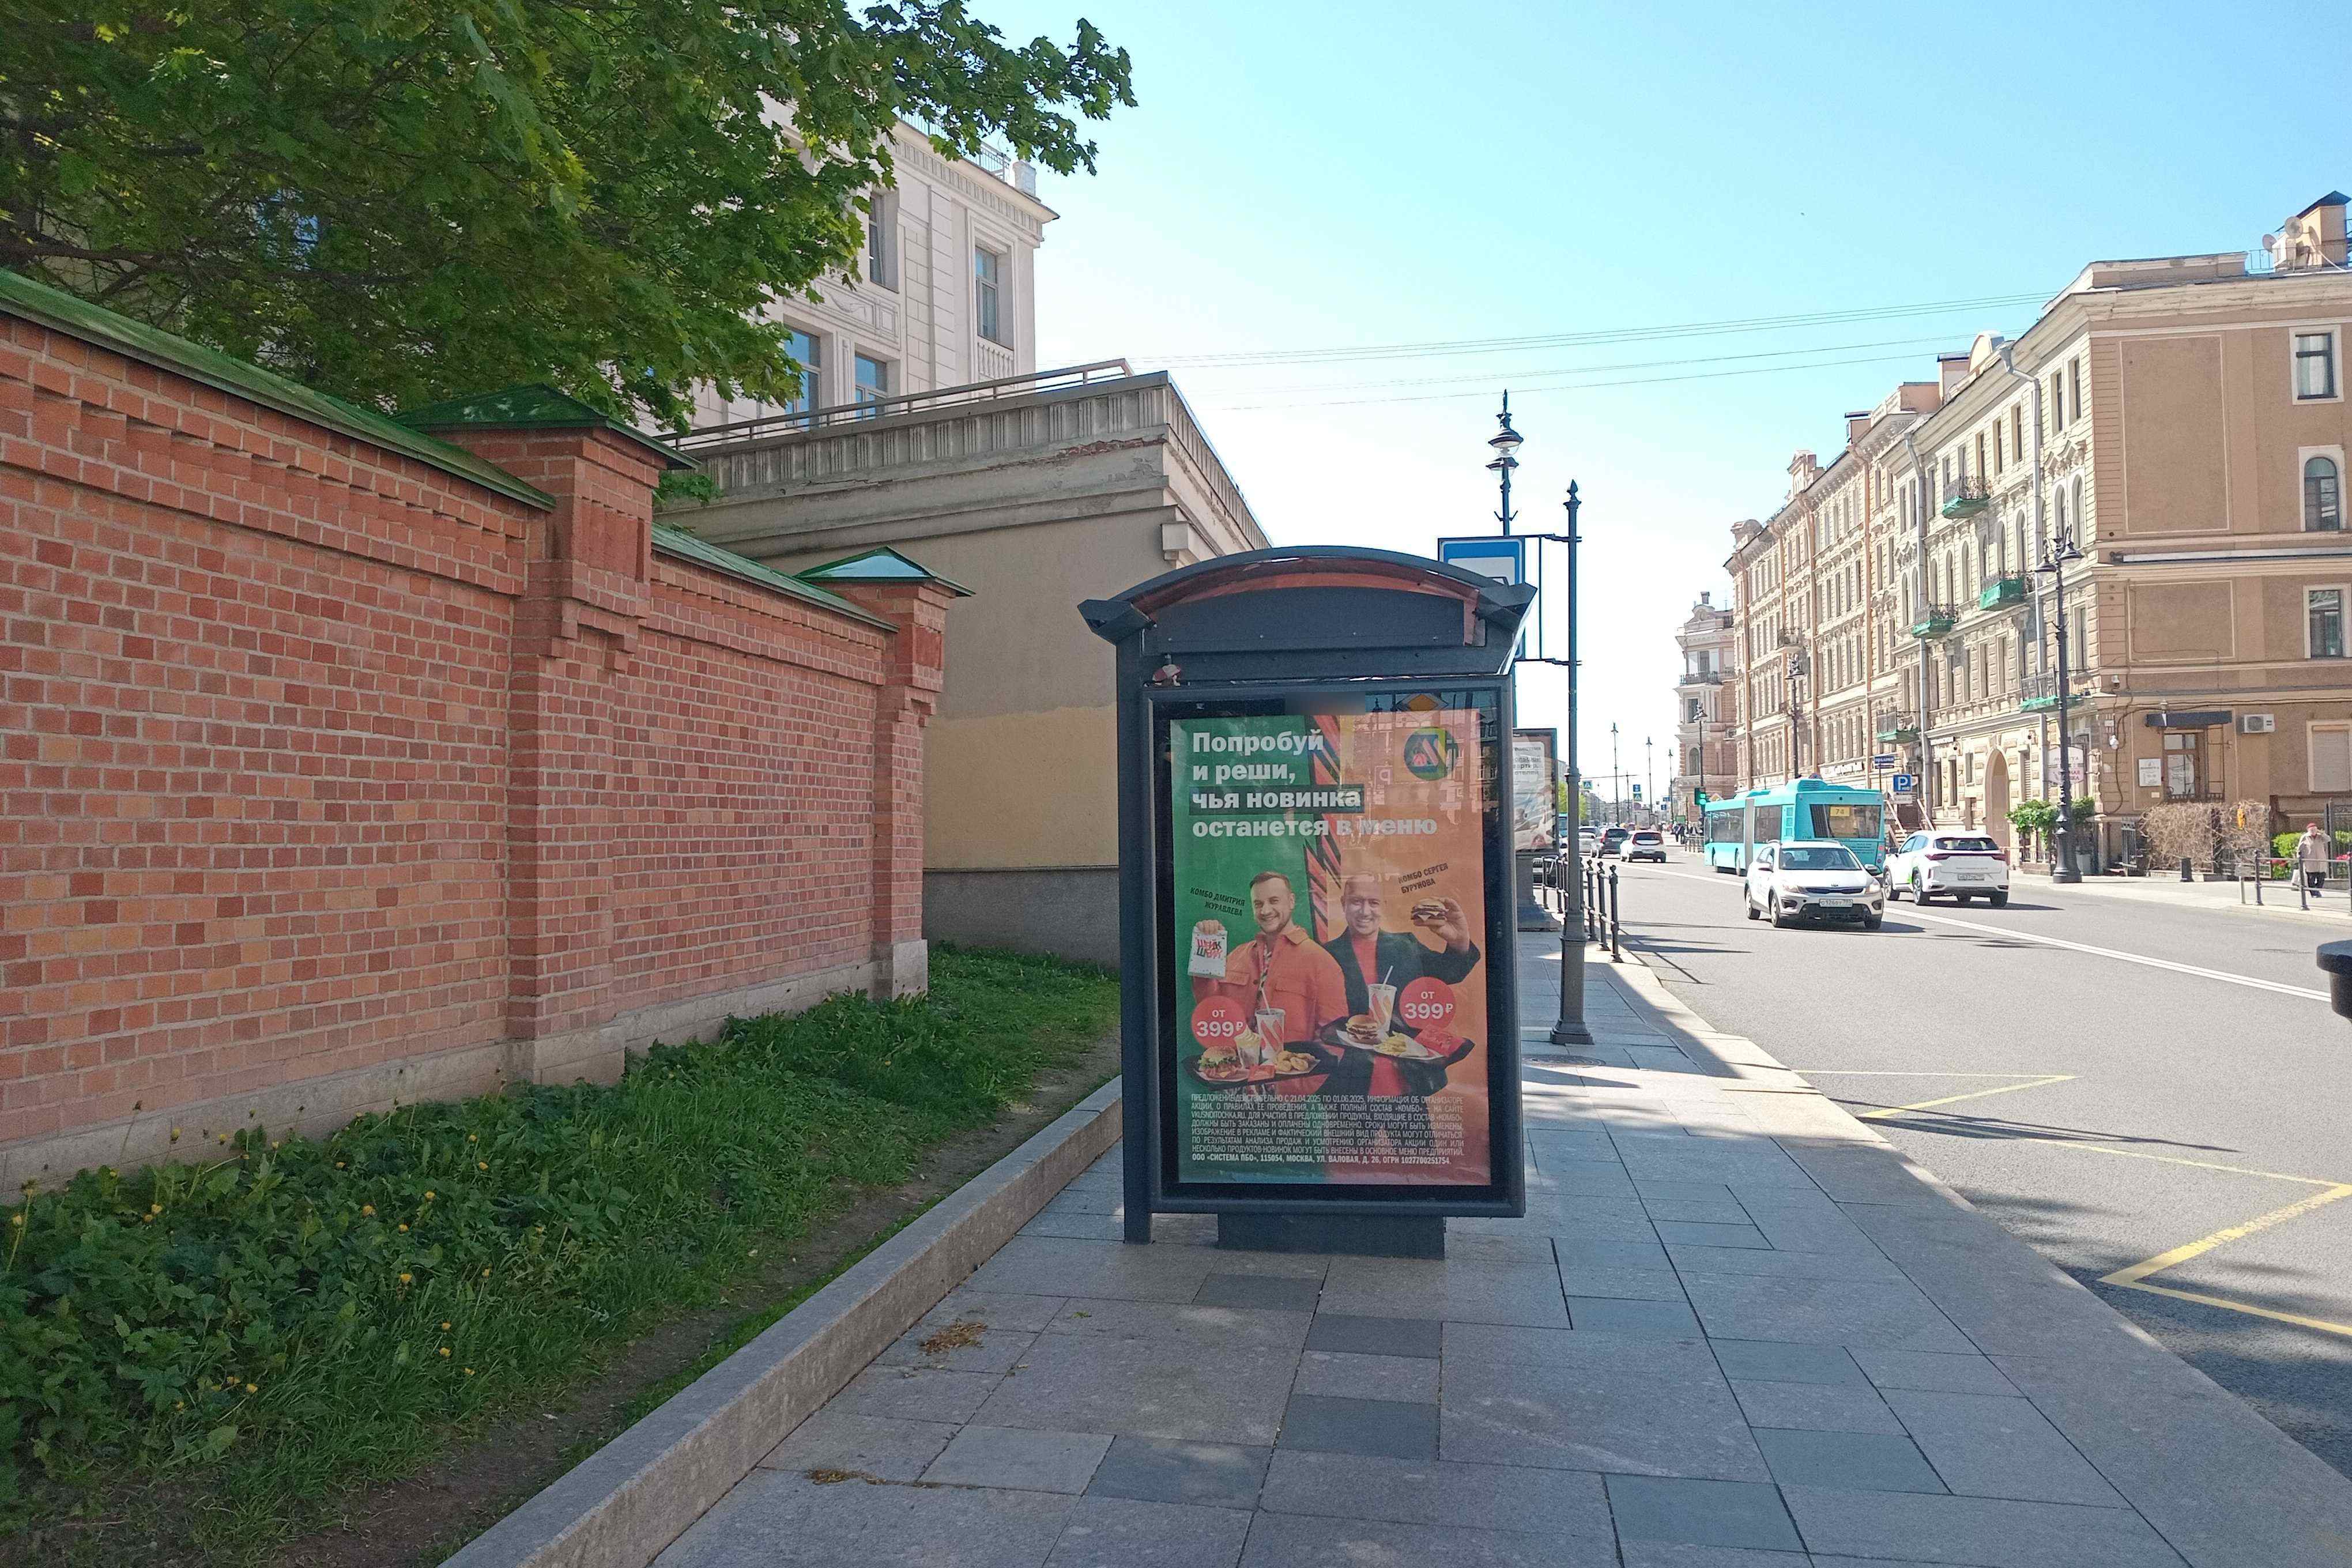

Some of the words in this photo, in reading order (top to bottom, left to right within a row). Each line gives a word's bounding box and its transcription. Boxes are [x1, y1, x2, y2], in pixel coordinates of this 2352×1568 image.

[1193, 729, 1324, 755] Попробуй
[1193, 766, 1208, 781] и
[1215, 763, 1296, 785] реши,
[1192, 791, 1240, 809] чья
[1247, 790, 1362, 808] новинка
[1193, 819, 1329, 838] останется
[1337, 820, 1352, 835] в
[1360, 818, 1438, 835] меню
[1397, 870, 1422, 884] КОМБО
[1423, 863, 1449, 876] СЕРГЕЯ
[1401, 877, 1436, 894] БУРУНОВА
[1190, 887, 1213, 899] КОМБО
[1213, 894, 1245, 906] ДМИТРИЯ
[1204, 901, 1242, 916] ЖУРАВЛЕВА
[1318, 1103, 1337, 1111] ТАКЖЕ
[1220, 1120, 1236, 1128] БЫТЬ
[1238, 1120, 1269, 1128] ЗАКАЗАНЫ
[1278, 1120, 1310, 1129] ОПЛАЧЕНЫ
[1365, 1121, 1386, 1129] СРОКИ
[1388, 1121, 1408, 1129] МОГУТ
[1409, 1121, 1426, 1129] БЫТЬ
[1192, 1128, 1235, 1137] ИЗОБРАЖЕНИЕ
[1243, 1129, 1270, 1137] РЕКЛАМЕ
[1277, 1129, 1322, 1137] ФАКТИЧЕСКИЙ
[1324, 1129, 1354, 1137] ВНЕШНИЙ
[1356, 1129, 1369, 1138] ВИД
[1370, 1130, 1401, 1138] ПРОДУКТА
[1403, 1130, 1423, 1138] МОГУТ
[1204, 1136, 1242, 1145] РЕЗУЛЬТАТАМ
[1245, 1137, 1273, 1145] АНАЛИЗА
[1276, 1137, 1302, 1145] ПРОДАЖ
[1313, 1137, 1354, 1146] УСМОТРЕНИЮ
[1357, 1138, 1402, 1146] ОРГАНИЗАТОРА
[1405, 1139, 1426, 1147] АКЦИИ
[1429, 1139, 1447, 1147] ОДИН
[1192, 1145, 1226, 1154] НЕСКОЛЬКО
[1292, 1145, 1313, 1154] МОГУТ
[1314, 1146, 1329, 1154] БЫТЬ
[1330, 1146, 1358, 1154] ВНЕСЕНЫ
[1366, 1147, 1397, 1155] ОСНОВНОЕ
[1399, 1147, 1417, 1155] МЕНЮ
[1192, 1154, 1205, 1162] ООО
[1207, 1154, 1239, 1162] «СИСТЕМА
[1286, 1155, 1315, 1163] МОСКВА,
[1328, 1155, 1360, 1163] ВАЛОВАЯ,
[1383, 1156, 1399, 1164] ОГРН
